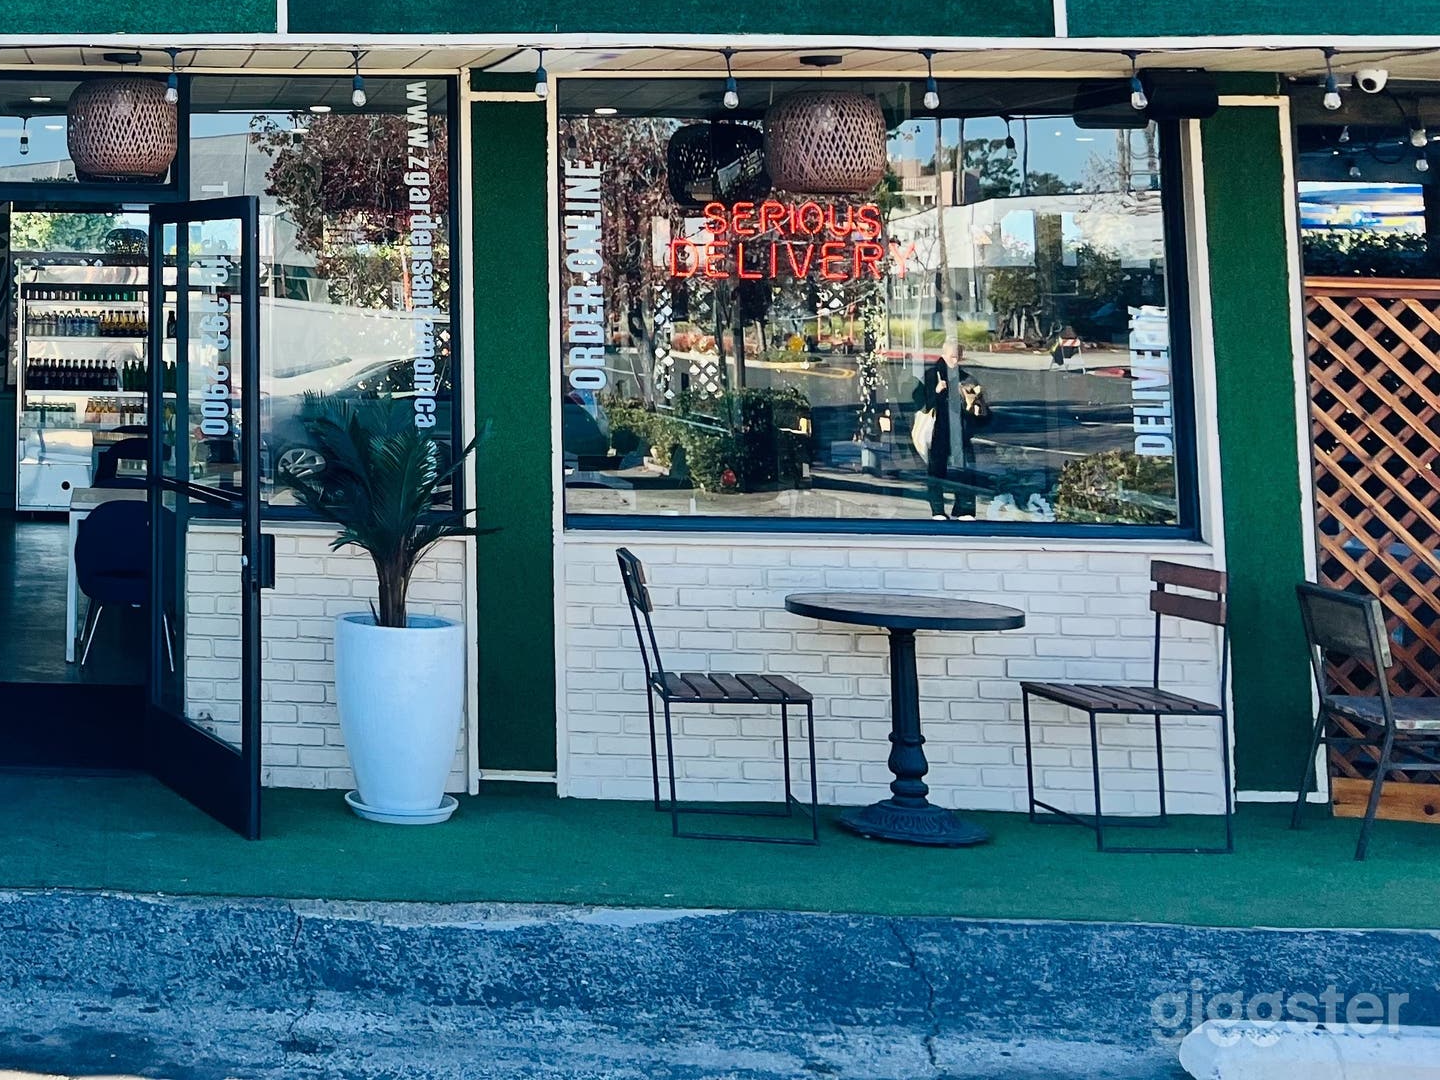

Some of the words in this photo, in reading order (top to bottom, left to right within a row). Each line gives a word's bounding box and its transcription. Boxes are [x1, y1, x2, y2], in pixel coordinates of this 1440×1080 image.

[564, 156, 604, 274] ONLINE
[703, 199, 882, 238] SERIOUS
[668, 237, 916, 281] DELIVERY
[568, 284, 607, 390] ORDER
